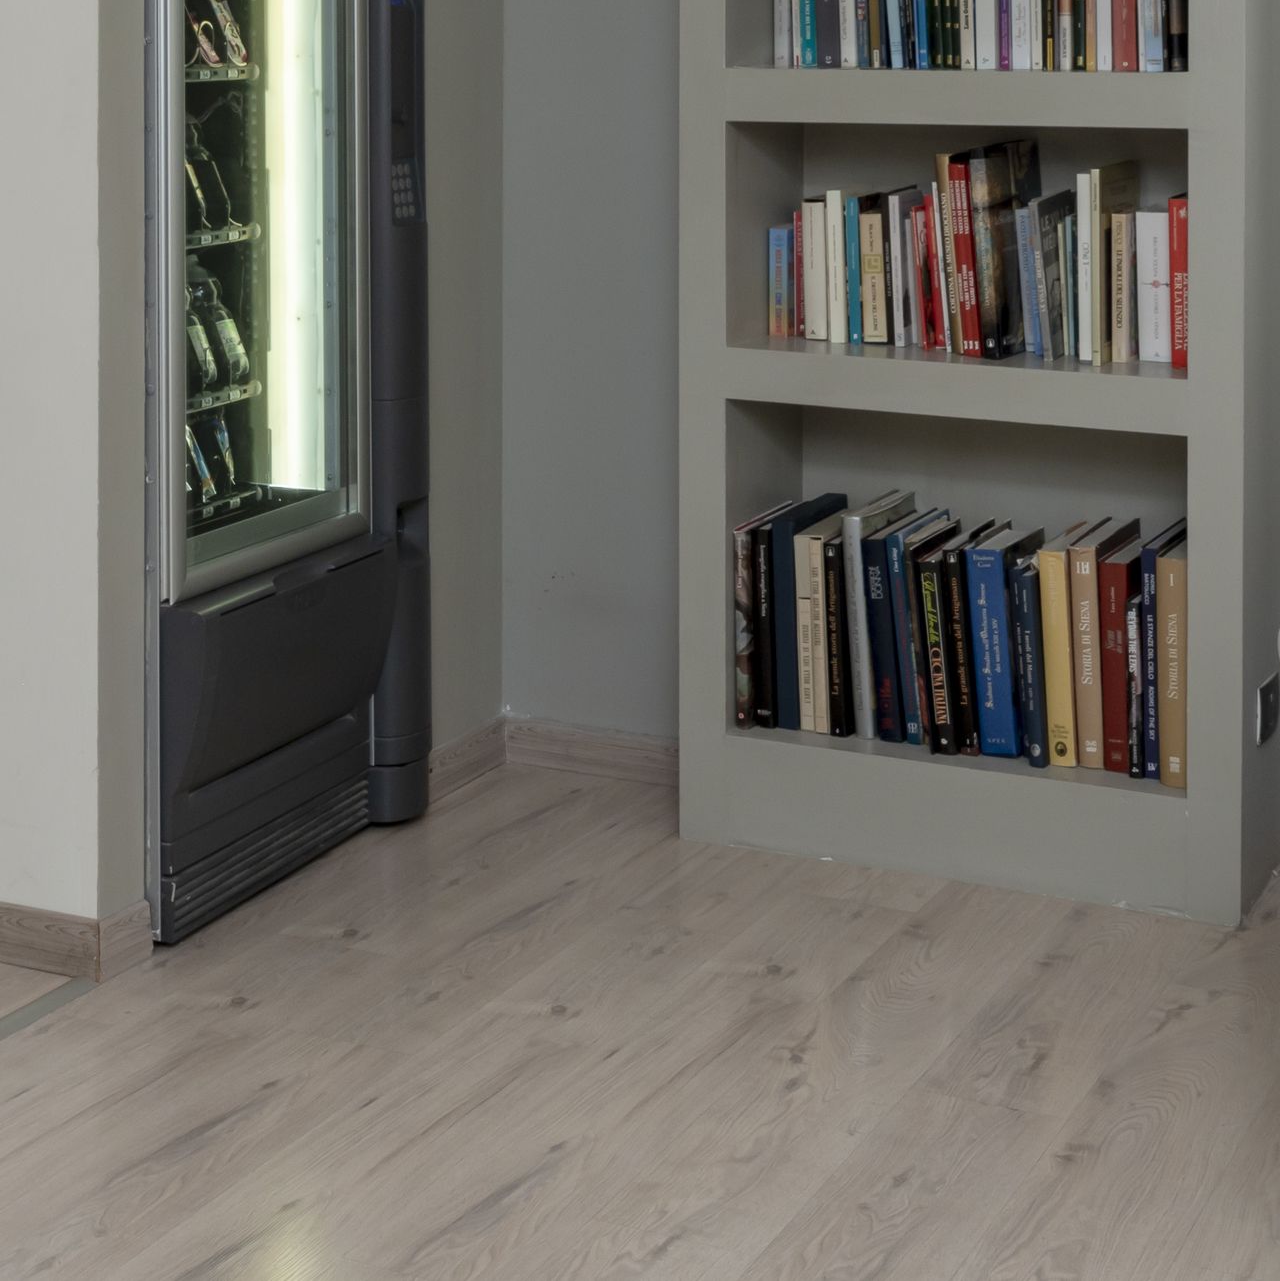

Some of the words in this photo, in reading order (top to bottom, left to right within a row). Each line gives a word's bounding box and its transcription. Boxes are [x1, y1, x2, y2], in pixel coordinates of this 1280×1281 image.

[941, 193, 949, 236] DIOCESANO
[944, 238, 952, 263] MUSEO
[946, 264, 953, 272] IL
[1174, 272, 1182, 289] PER
[947, 277, 956, 313] CORTONA
[1175, 291, 1182, 302] LA
[1174, 305, 1183, 350] FAMIGLIA
[951, 577, 961, 620] Artigianato
[1079, 600, 1090, 631] SIENA
[1166, 613, 1177, 644] SIENA
[830, 633, 838, 655] storia
[955, 640, 963, 663] storia
[1128, 641, 1136, 654] THE
[1169, 648, 1178, 658] DI
[831, 657, 840, 683] grande
[957, 665, 967, 693] grande
[1081, 648, 1093, 685] STORIA
[831, 685, 839, 695] La
[1167, 661, 1178, 699] STORIA
[935, 689, 947, 724] ITALIANA
[959, 695, 968, 706] La
[1149, 708, 1155, 716] OF
